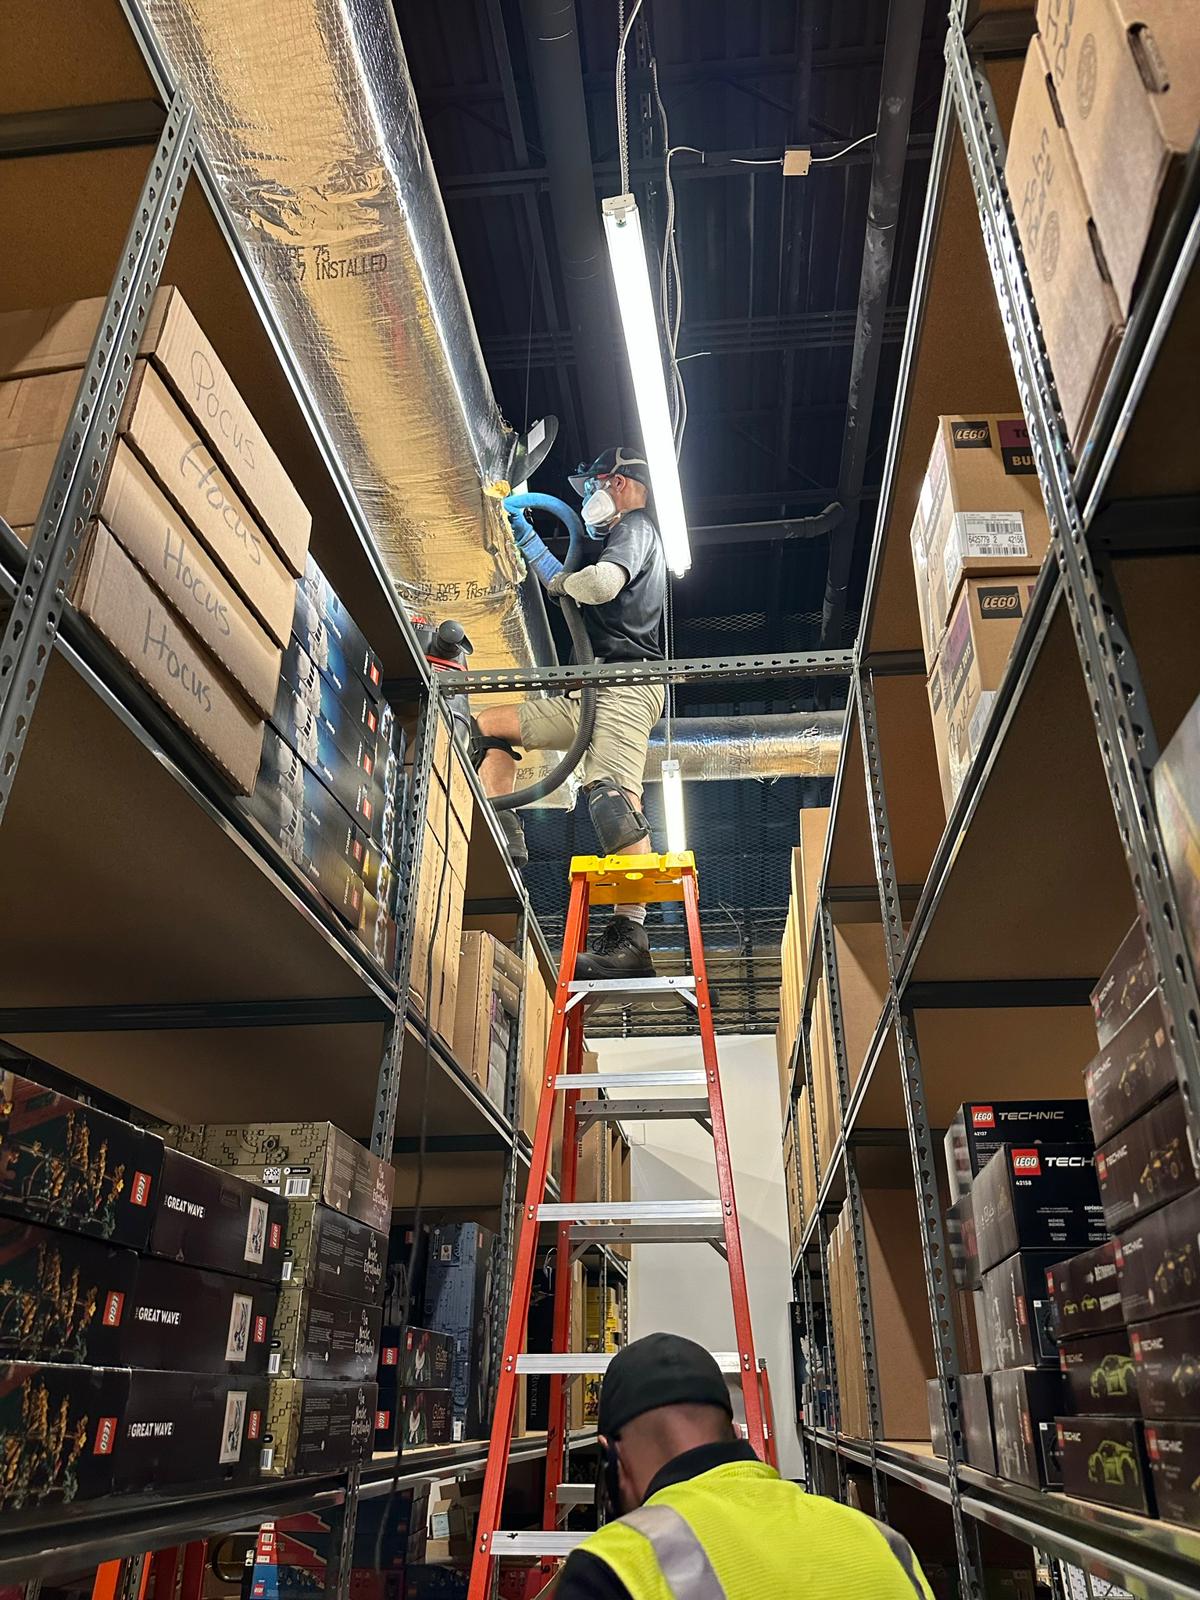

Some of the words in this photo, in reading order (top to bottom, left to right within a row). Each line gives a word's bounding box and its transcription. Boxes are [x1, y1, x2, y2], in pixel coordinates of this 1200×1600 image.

[312, 244, 331, 264] 75
[315, 253, 388, 281] INSTALLED
[190, 349, 256, 471] Pocus
[954, 428, 988, 441] LEGO
[179, 440, 262, 566] Hocus
[162, 526, 231, 637] Hocus
[437, 582, 461, 594] TYPE
[982, 595, 1018, 610] LEGO
[142, 606, 213, 715] Hocus
[974, 1111, 993, 1122] LEGO
[999, 1111, 1065, 1121] TECHNIC
[1014, 1155, 1039, 1168] LEGO
[167, 1194, 186, 1213] GREAT
[187, 1200, 205, 1219] WAVE
[108, 1295, 119, 1324] LEGO
[138, 1306, 160, 1323] GREAT
[161, 1309, 180, 1325] WAVE
[256, 1317, 264, 1341] LEGO
[100, 1418, 112, 1451] LEGO
[131, 1422, 154, 1438] GREAT
[154, 1421, 173, 1436] WAVE
